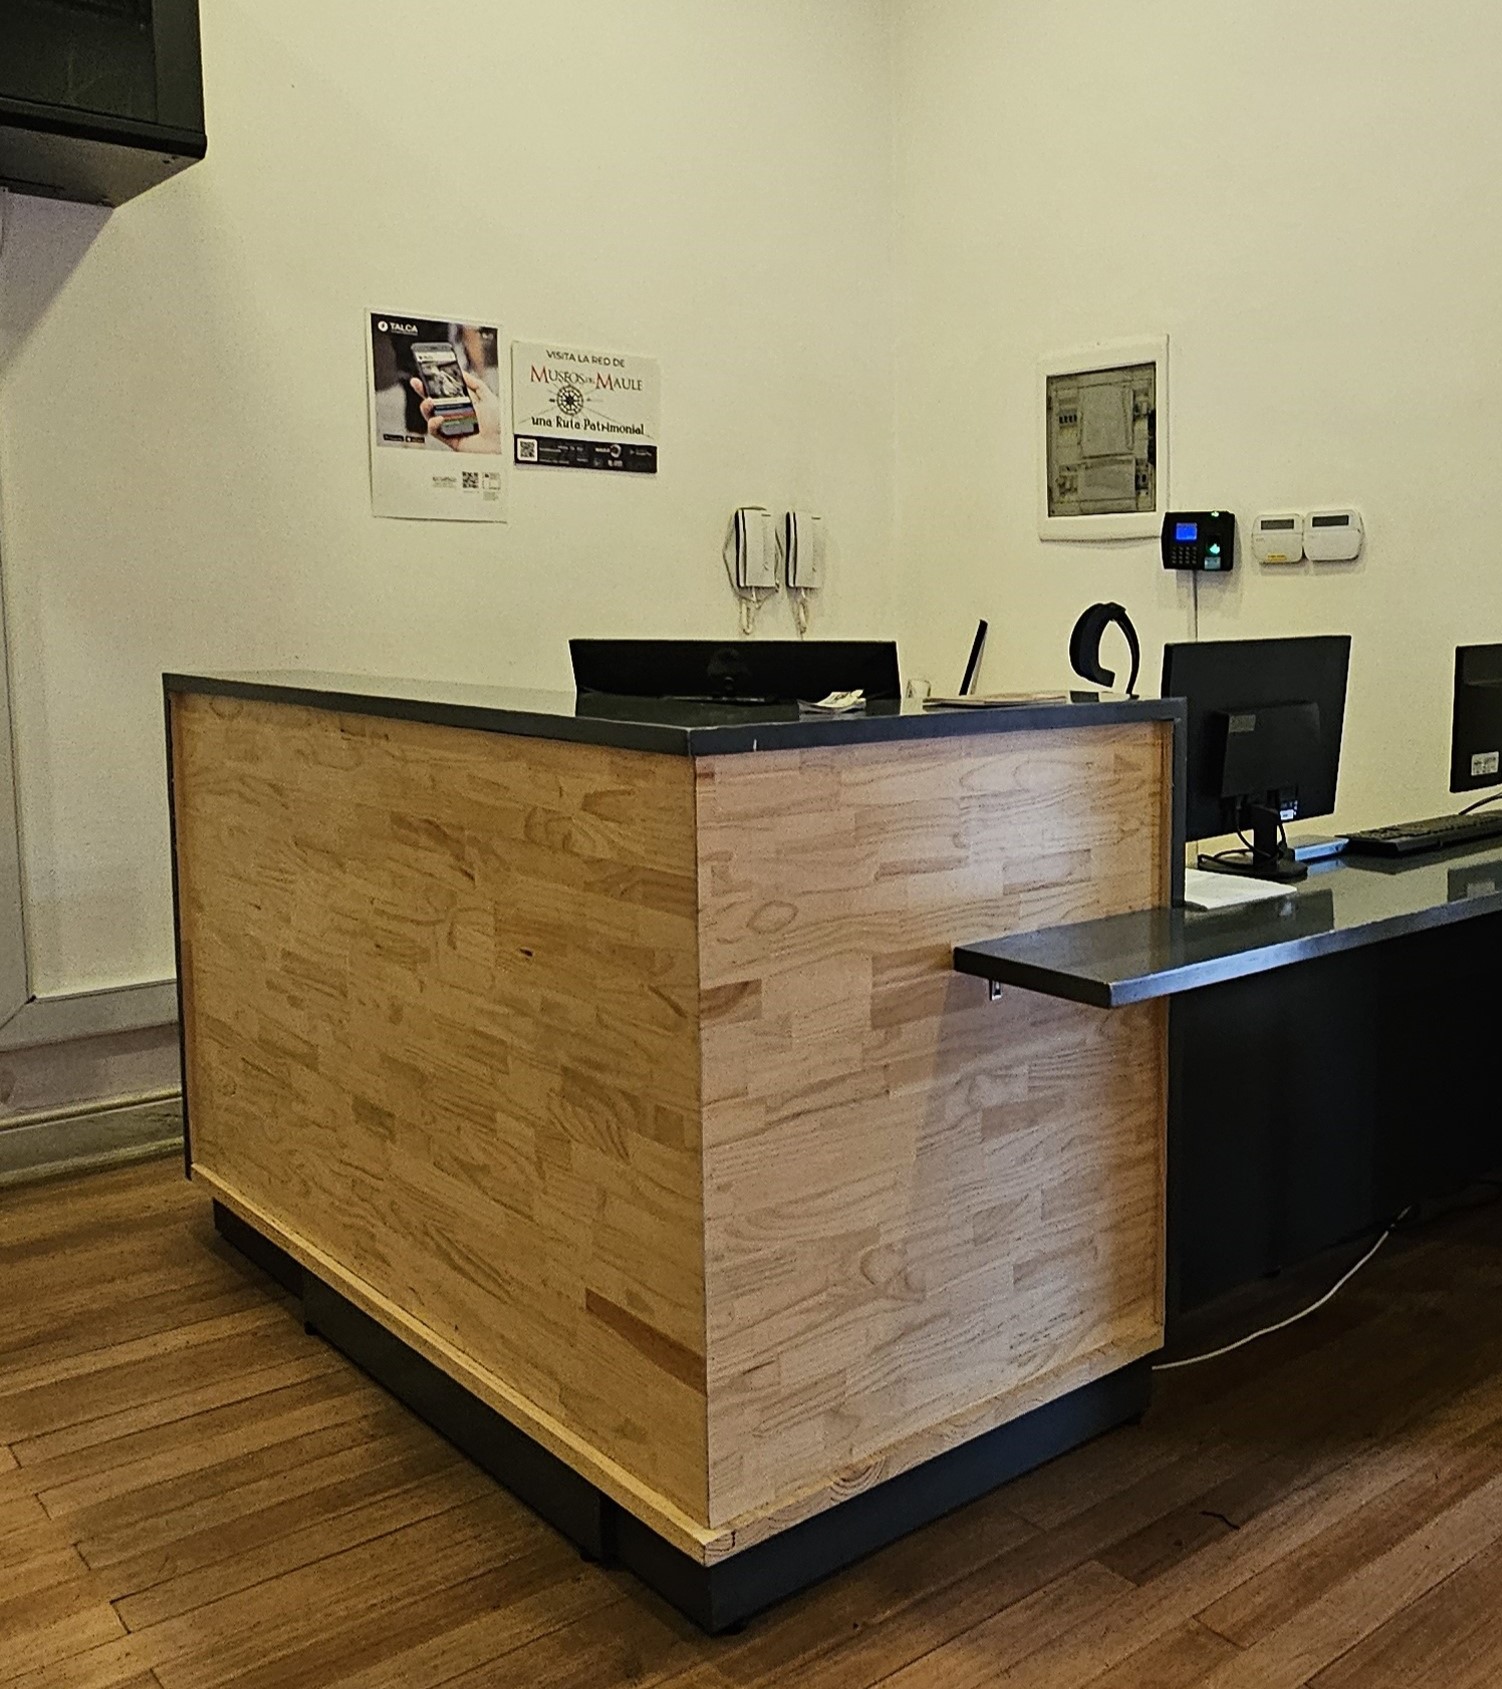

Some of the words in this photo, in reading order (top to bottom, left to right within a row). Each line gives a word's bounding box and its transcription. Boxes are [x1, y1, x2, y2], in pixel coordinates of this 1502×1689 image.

[389, 322, 418, 333] TALCA
[546, 349, 576, 362] VISITA
[577, 355, 590, 364] LA
[591, 356, 611, 367] RED
[612, 358, 625, 368] DE
[530, 365, 586, 385] MUSEOS
[595, 372, 643, 391] MAULE
[531, 416, 552, 428] una
[556, 415, 580, 430] Ruta
[583, 418, 644, 435] Patrimonial
